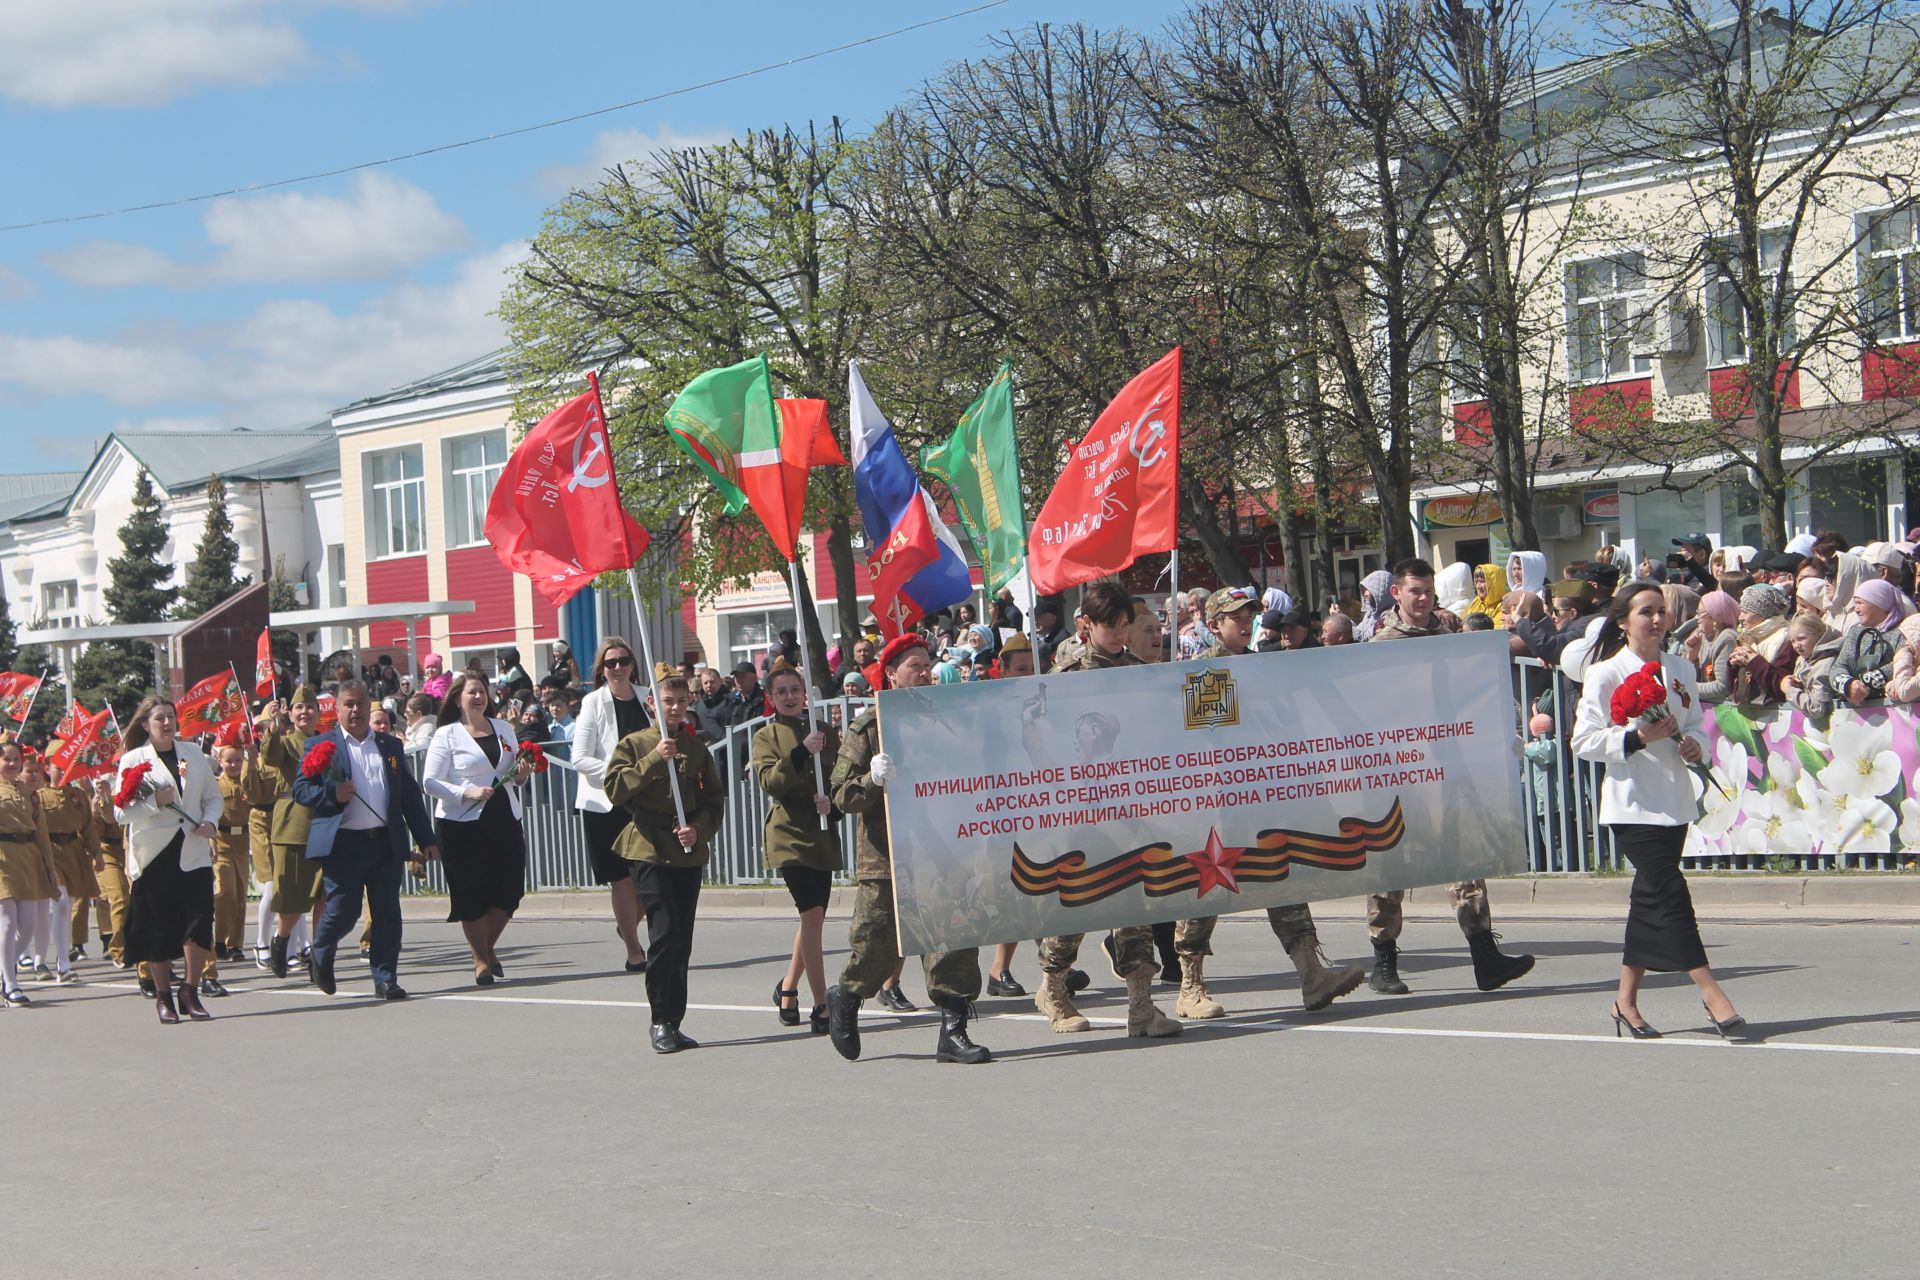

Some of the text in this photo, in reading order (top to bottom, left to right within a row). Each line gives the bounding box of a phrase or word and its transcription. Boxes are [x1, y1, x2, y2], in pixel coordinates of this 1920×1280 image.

[1194, 702, 1228, 717] АРЧА
[914, 721, 1475, 798] МУНИЦИПАЛЬНОЕ БЮДЖЕТНОЕ ОБЩЕОБРАЗОВАТЕЛЬНОЕ УЧРЕЖДЕНИЕ
[975, 748, 1426, 814] «АРСКАЯ СРЕДНЯЯ ОБЩЕОБРАЗОВАТЕЛЬНАЯ ШКОЛА №6»
[956, 766, 1445, 839] АРСКОГО МУНИЦИПАЛЬНОГО РАЙОНА РЕСПУБЛИКИ ТАТАРСТАН
